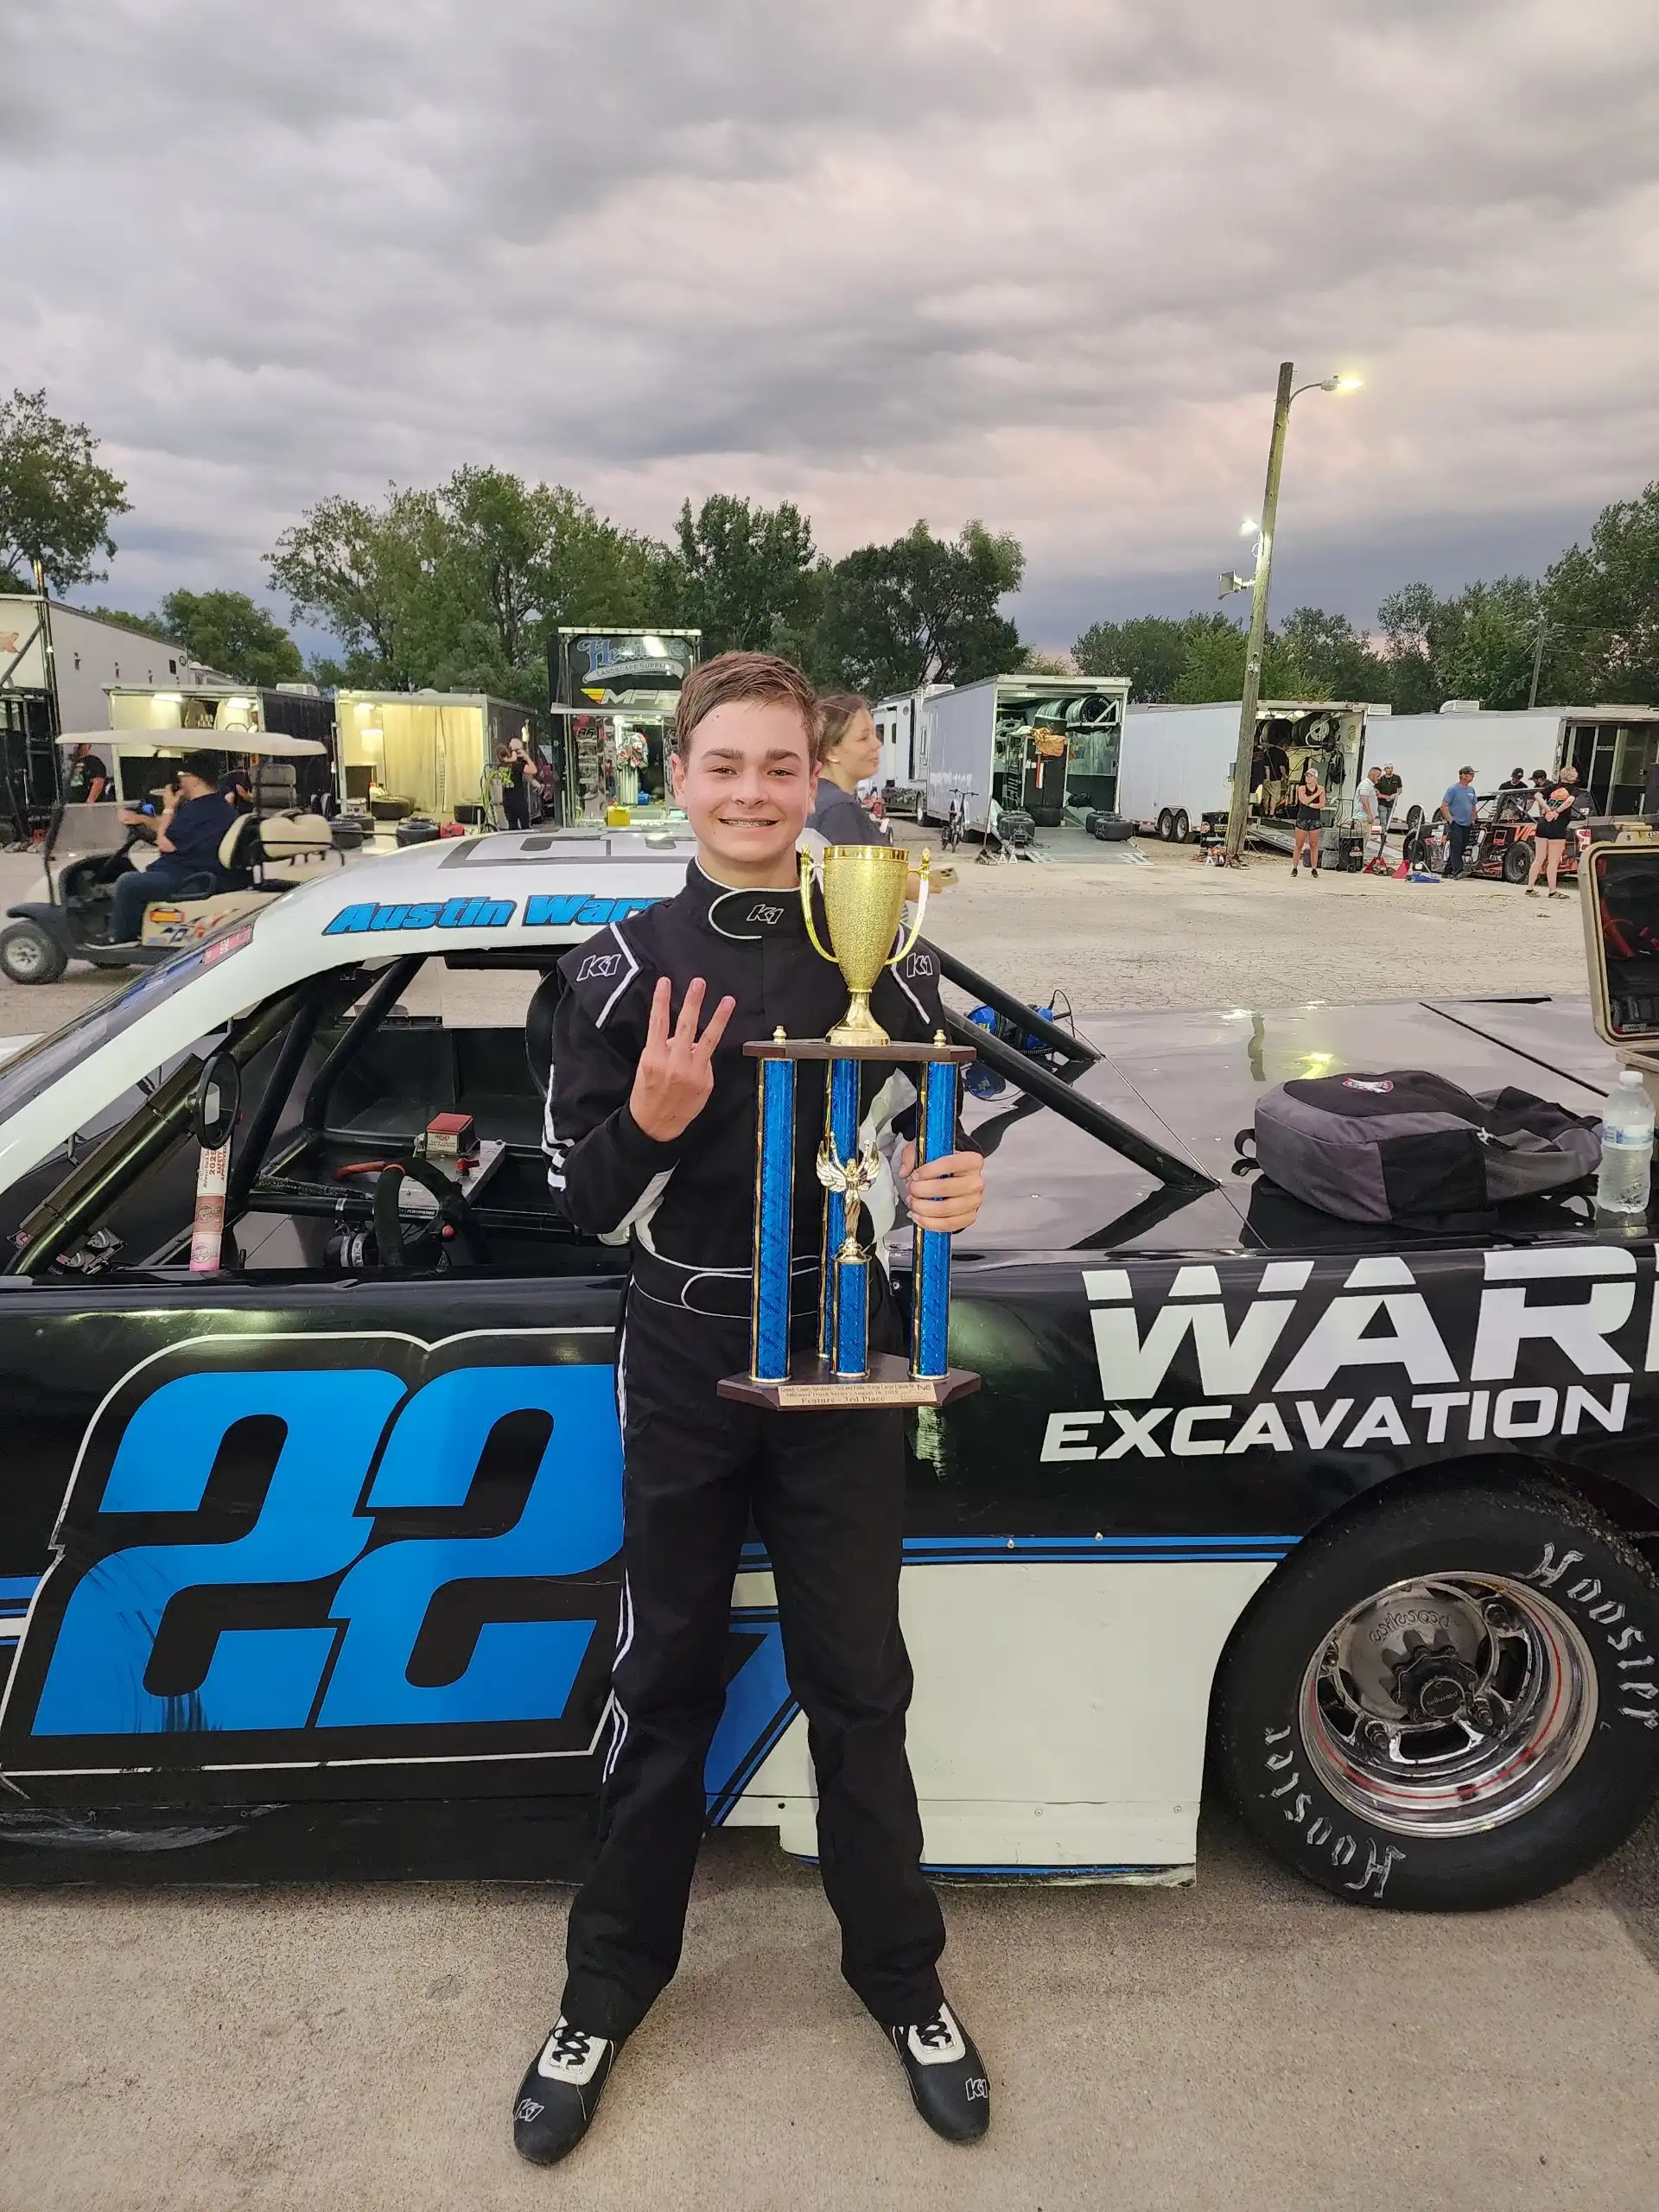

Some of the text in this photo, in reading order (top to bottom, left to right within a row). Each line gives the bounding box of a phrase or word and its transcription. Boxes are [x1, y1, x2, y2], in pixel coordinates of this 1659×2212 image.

[596, 664, 639, 677] LANDSCAPE
[321, 894, 667, 936] Austin War
[746, 904, 785, 925] K1
[576, 953, 621, 982] K1
[906, 952, 934, 978] K1
[1082, 1243, 1659, 1401] WAR
[1039, 1383, 1630, 1462] EXCAVATION
[31, 1364, 626, 1736] 22
[965, 2077, 988, 2101] K1
[514, 2097, 545, 2121] K1
